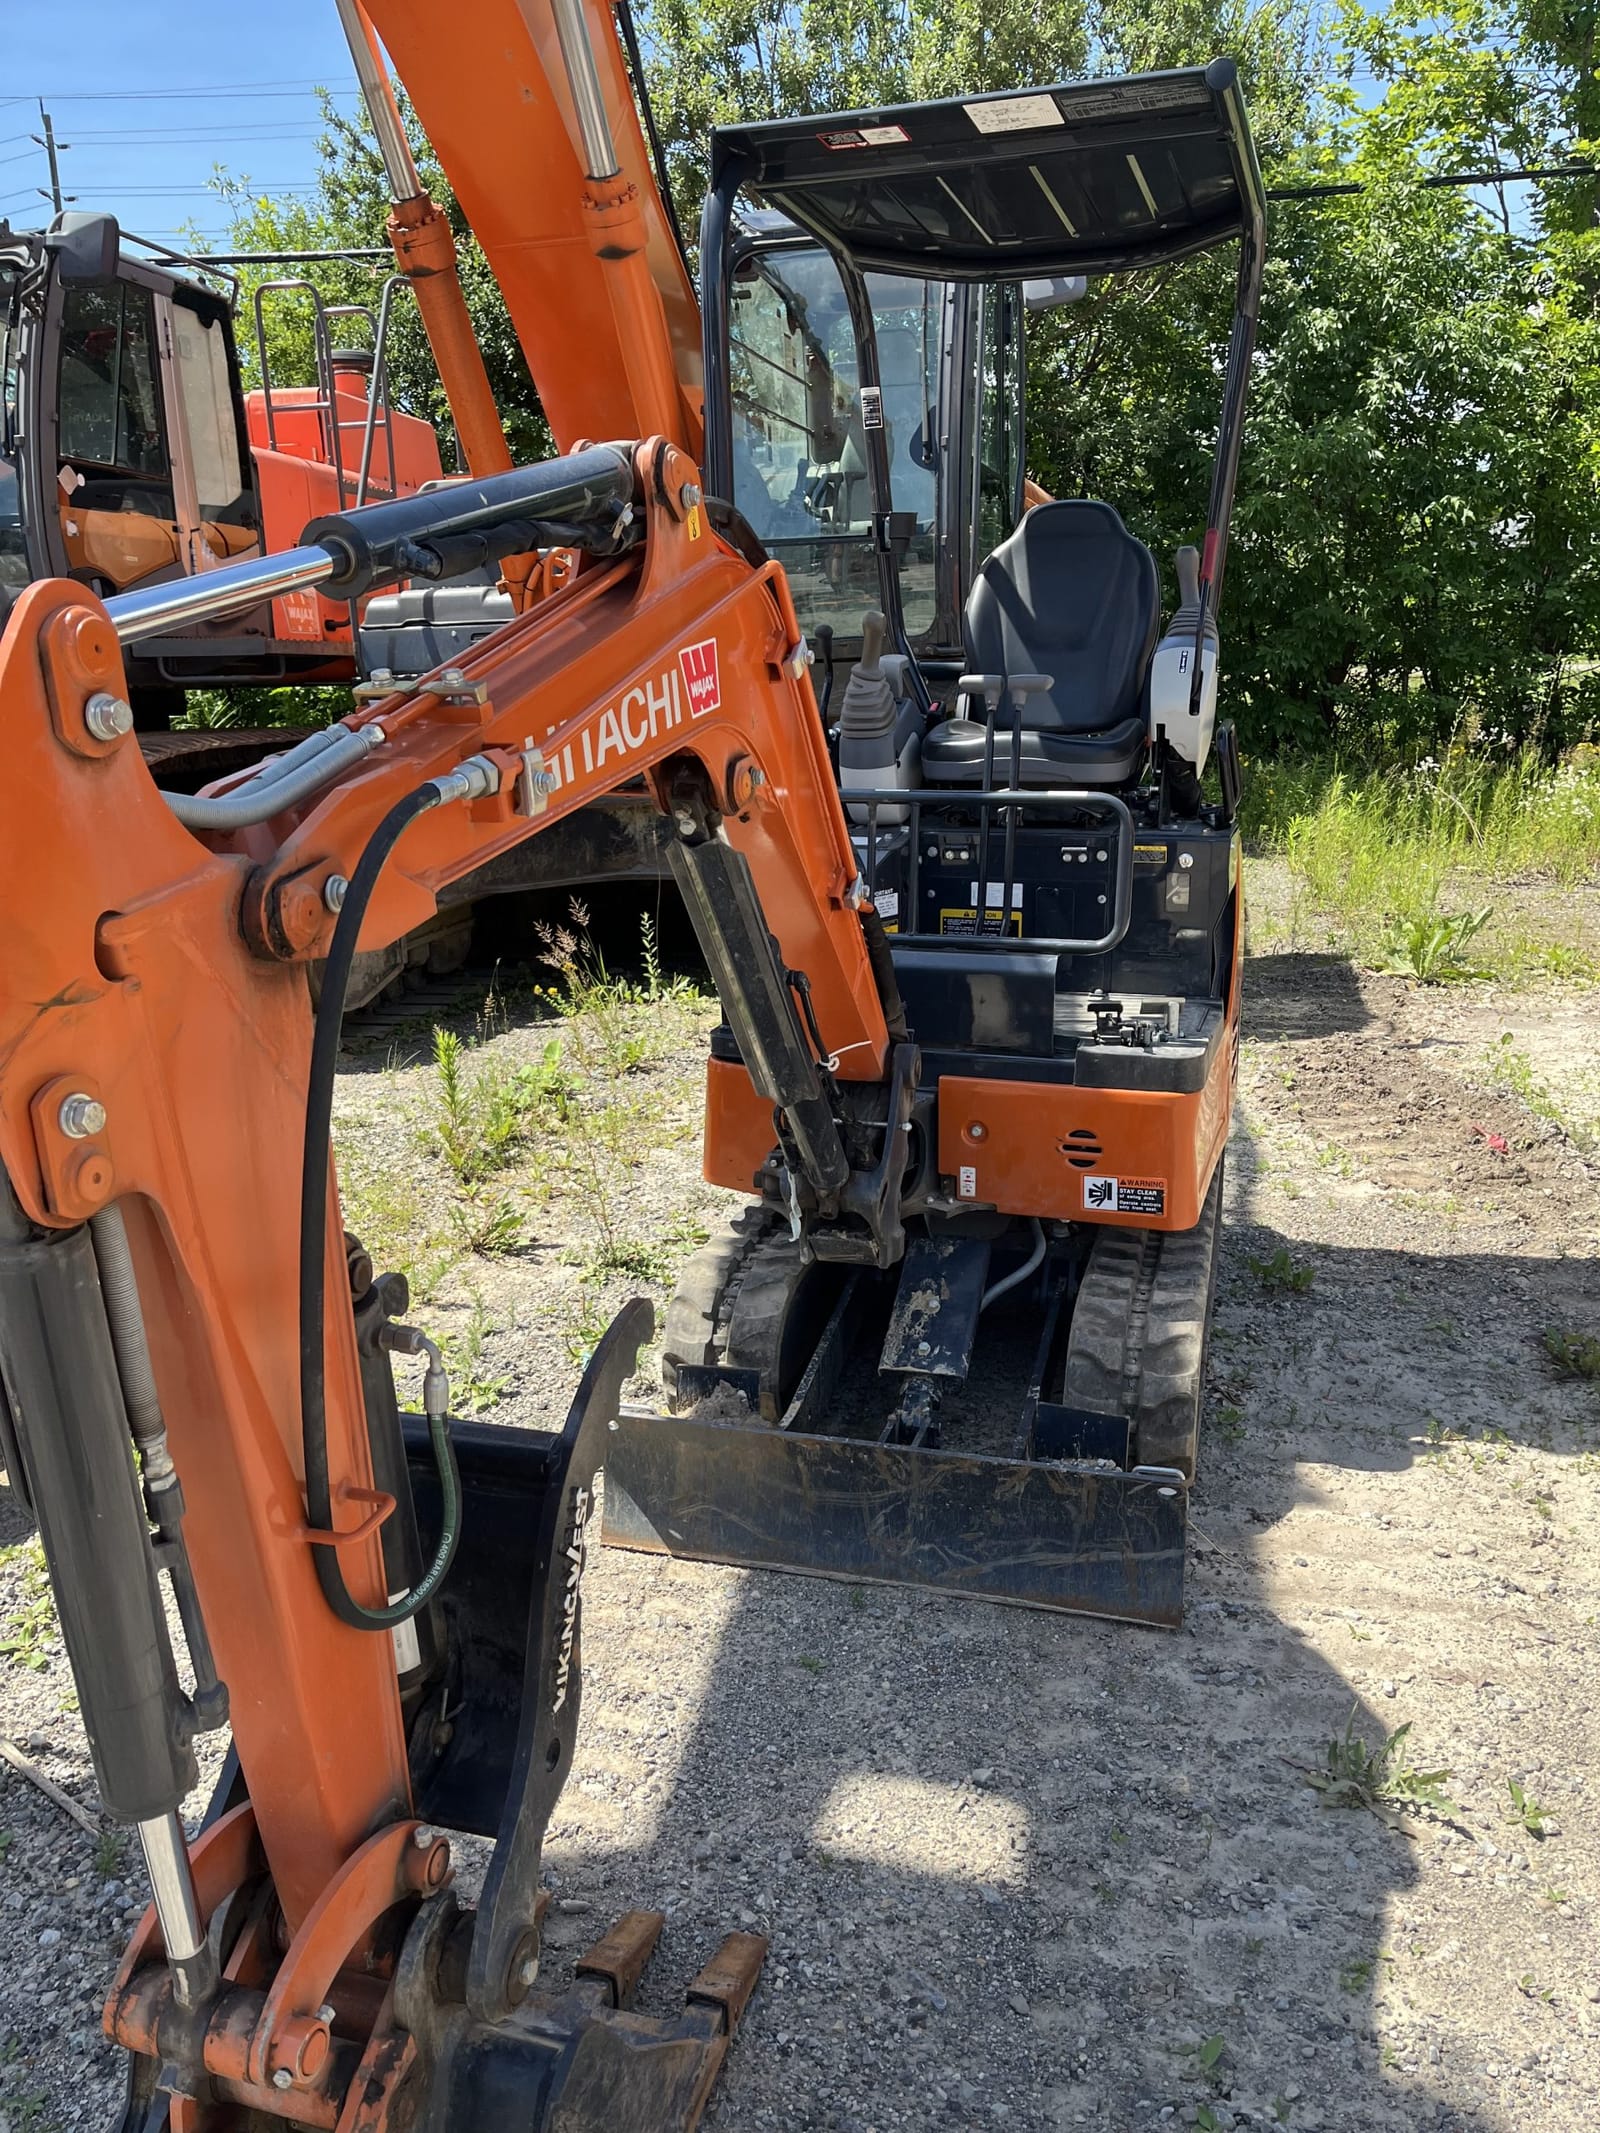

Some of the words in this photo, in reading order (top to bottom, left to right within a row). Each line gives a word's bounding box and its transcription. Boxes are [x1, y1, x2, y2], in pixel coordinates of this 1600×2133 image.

[288, 606, 314, 623] WAJAX
[690, 674, 715, 698] WAJAX
[1125, 1179, 1165, 1189] WARNING
[438, 1542, 449, 1560] 400
[431, 1558, 444, 1577] BAR
